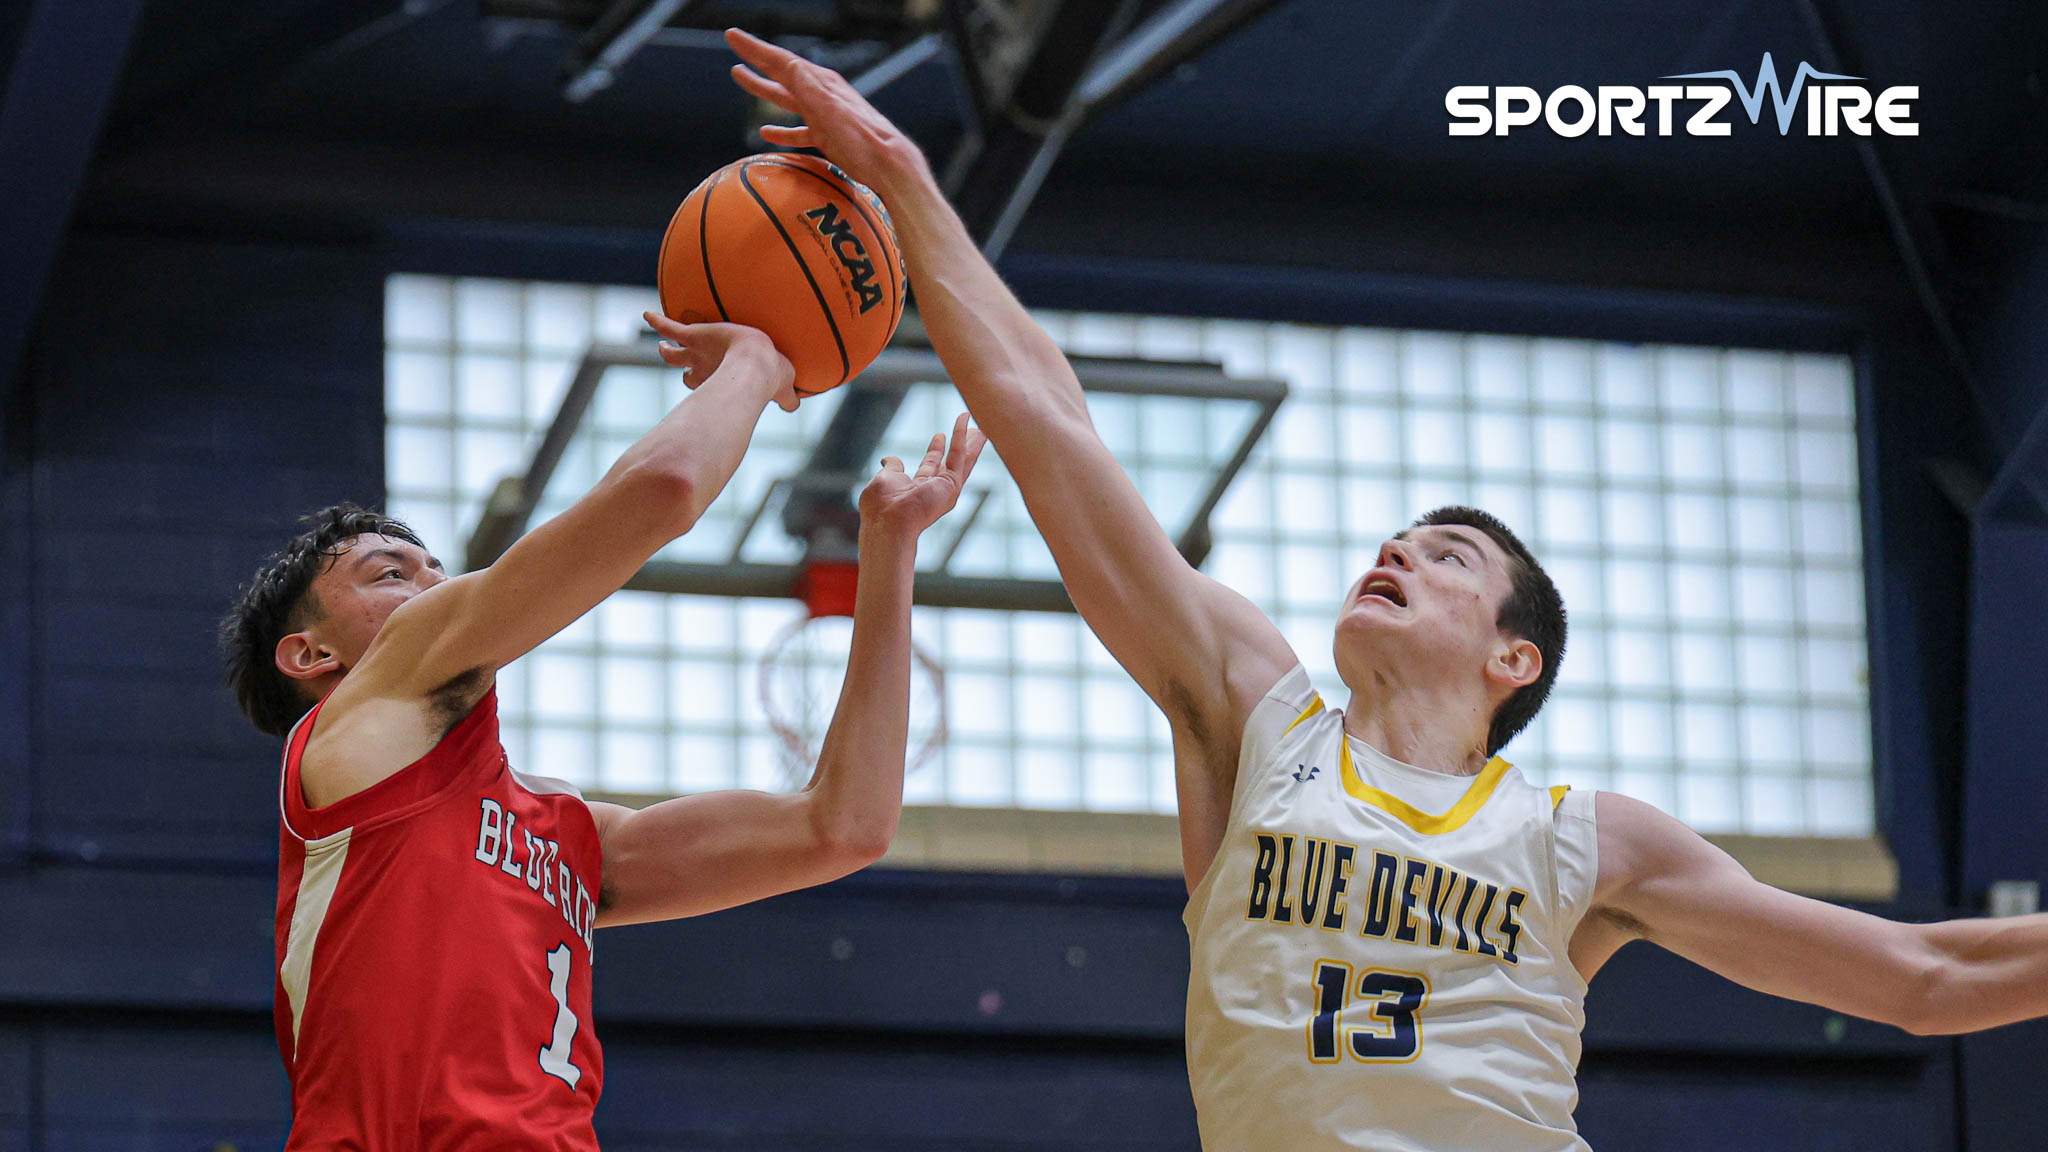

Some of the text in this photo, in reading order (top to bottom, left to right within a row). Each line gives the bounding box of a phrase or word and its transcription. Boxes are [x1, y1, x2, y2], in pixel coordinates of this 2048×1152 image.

[804, 202, 883, 316] NCAA
[475, 798, 560, 908] BLUE
[1245, 832, 1529, 967] BLUE DEVILS
[538, 941, 582, 1092] 1
[1306, 958, 1432, 1065] 13
